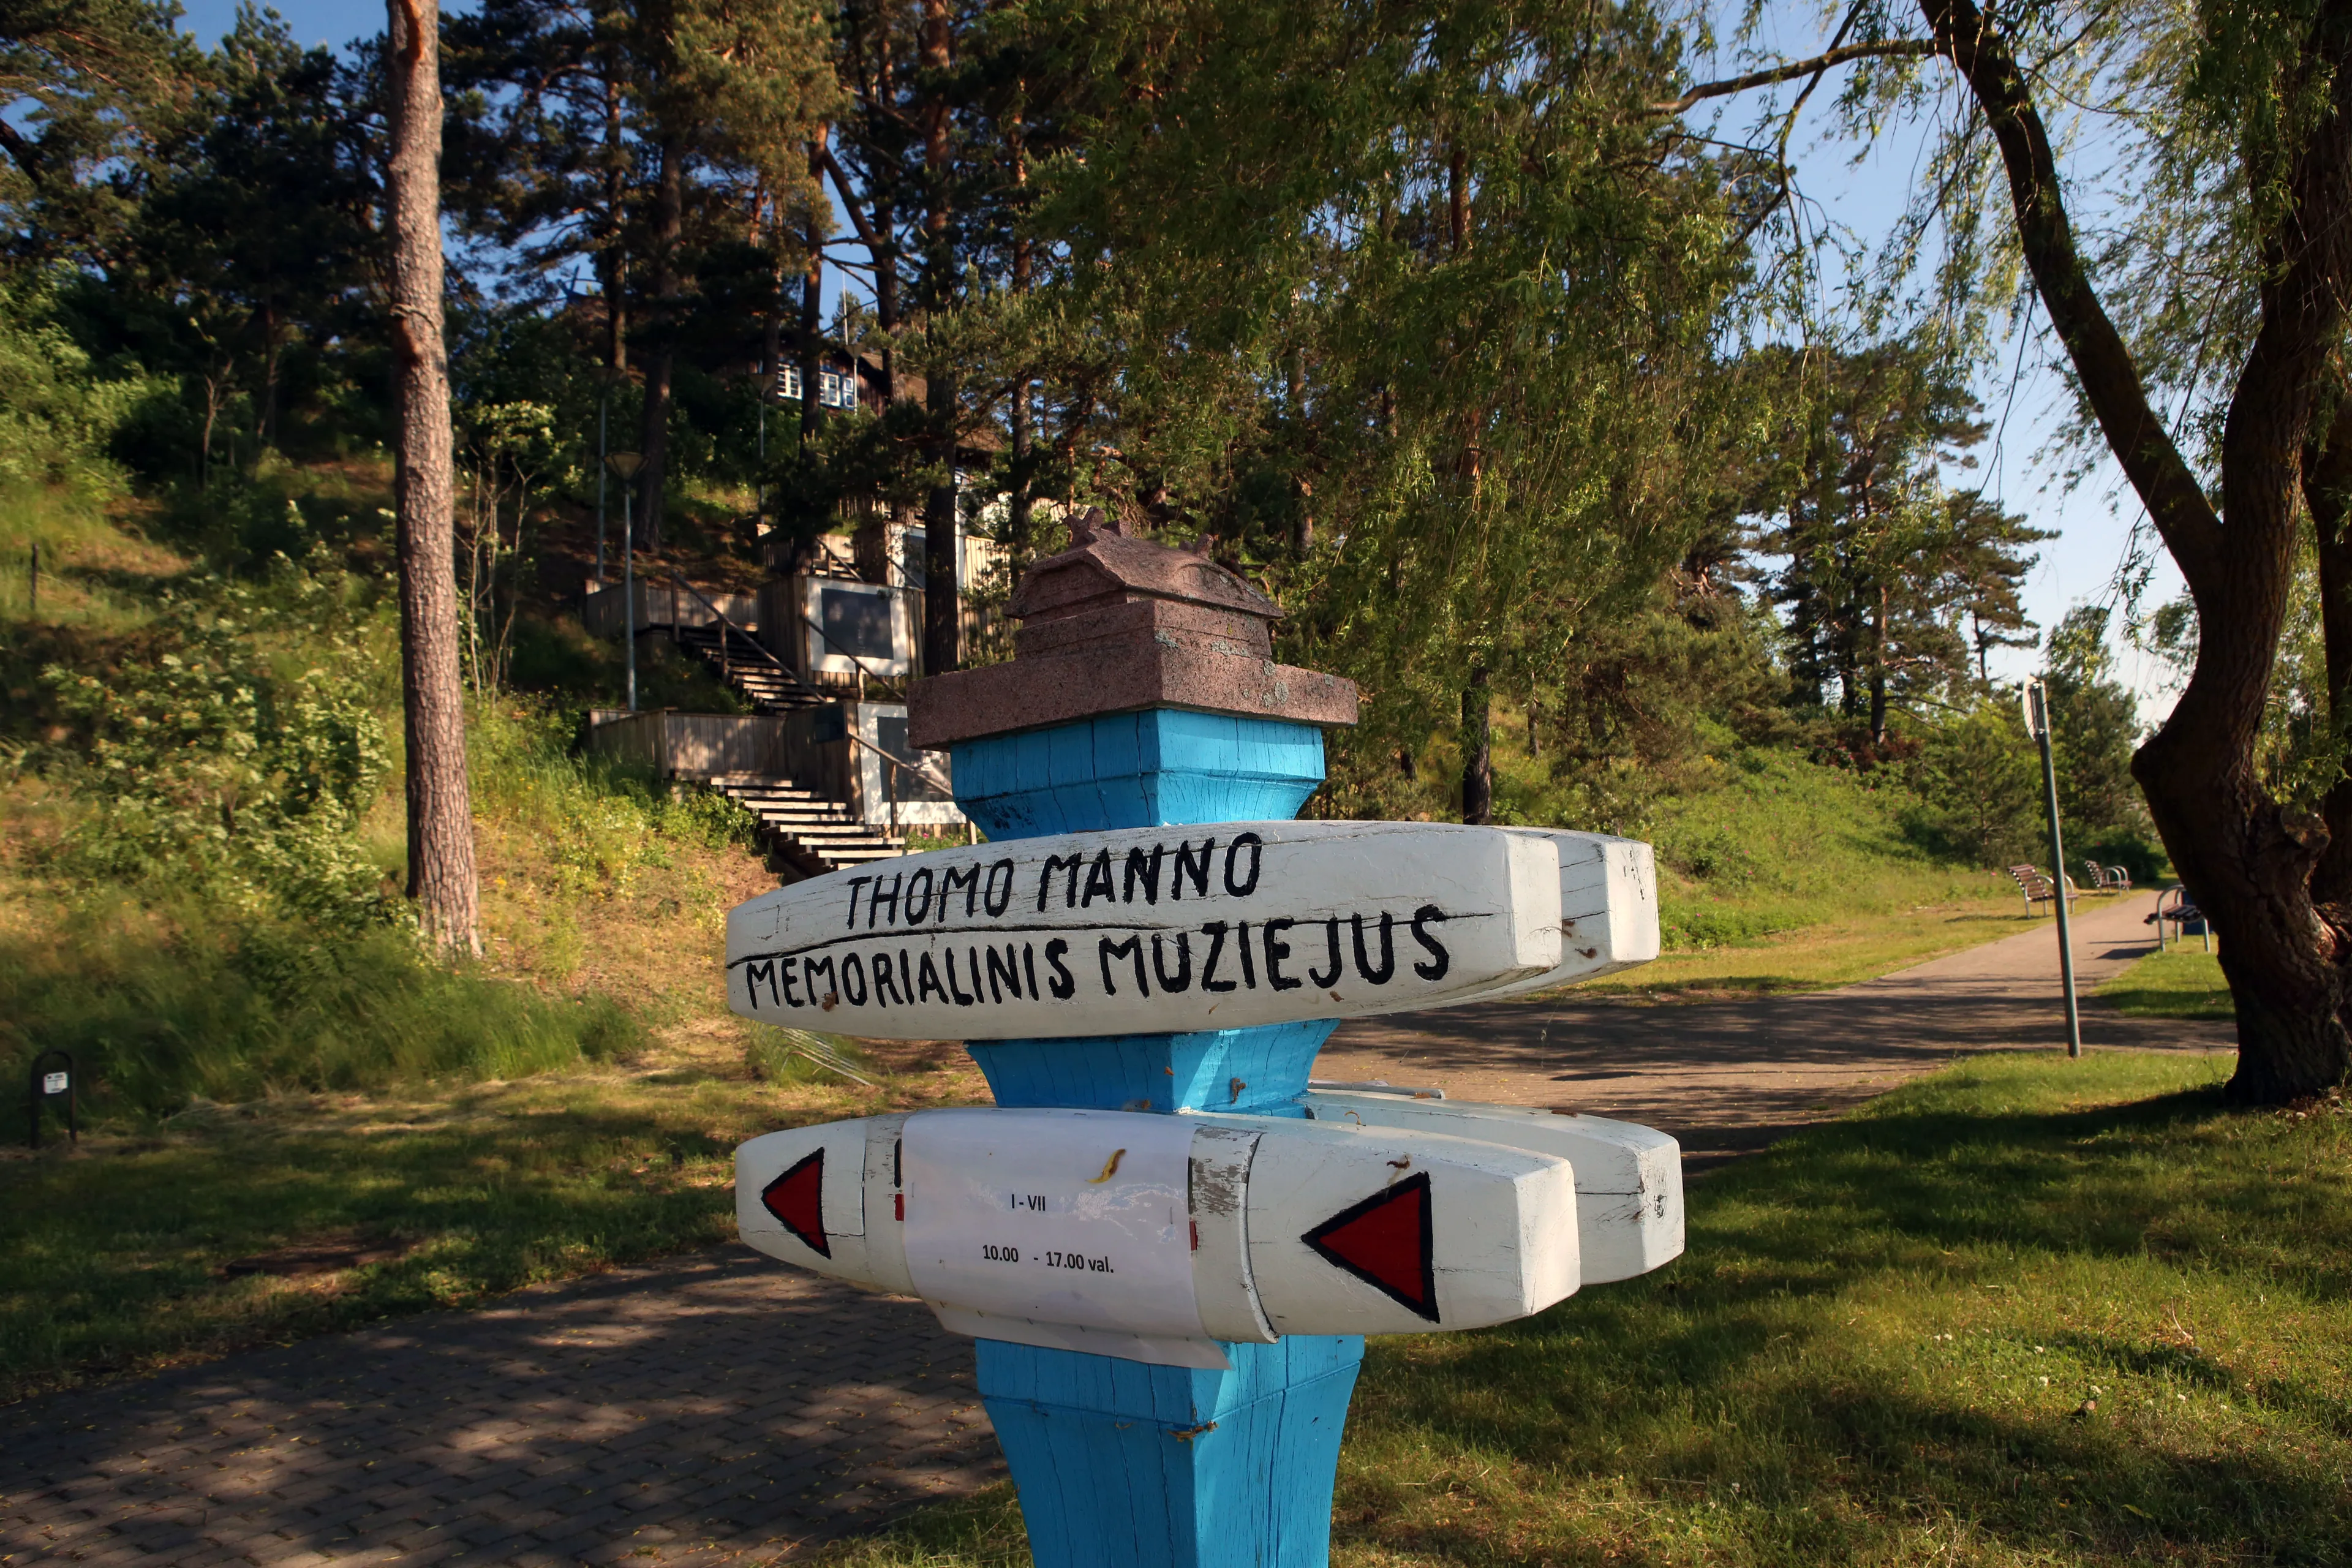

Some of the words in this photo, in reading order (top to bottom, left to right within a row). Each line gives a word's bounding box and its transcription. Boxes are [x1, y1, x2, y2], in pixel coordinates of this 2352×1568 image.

[846, 859, 1014, 930] THOMO
[1037, 832, 1262, 913] MANNO
[745, 941, 1076, 1009] MEMORIALINIS
[1099, 904, 1449, 998] MUZIEJUS
[1027, 1194, 1046, 1212] VII
[982, 1245, 1019, 1263] 10.00
[1046, 1251, 1084, 1270] 17.00
[1087, 1256, 1115, 1273] val.
